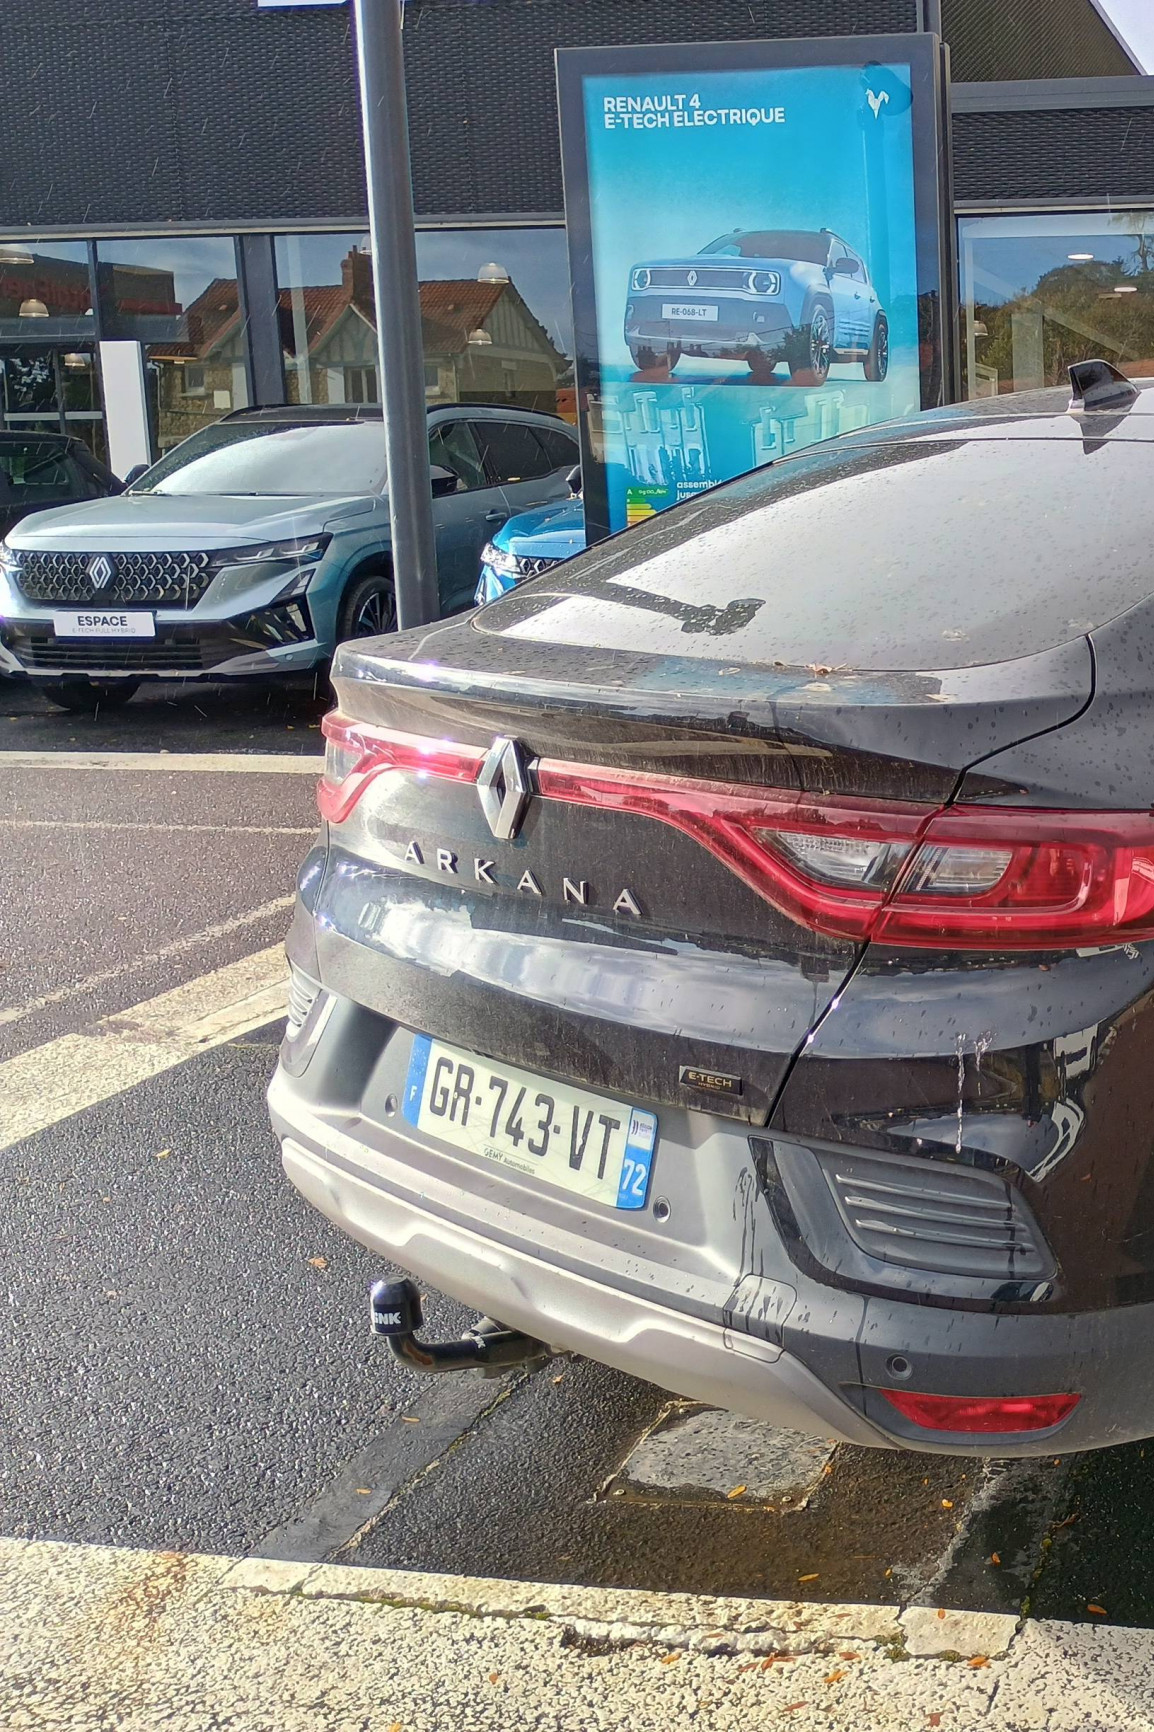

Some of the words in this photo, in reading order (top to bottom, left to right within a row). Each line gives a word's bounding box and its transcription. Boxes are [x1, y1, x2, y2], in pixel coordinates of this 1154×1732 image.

[603, 94, 687, 112] RENAULT
[689, 93, 701, 109] 4
[604, 112, 670, 129] E-TECH
[673, 107, 786, 127] ELECTRIQUE
[77, 615, 128, 626] ESPACE
[403, 840, 644, 916] ARKANA
[688, 1071, 732, 1088] E-TECH
[409, 1085, 418, 1101] F
[429, 1056, 621, 1180] GR-743-VT
[621, 1158, 647, 1196] 72
